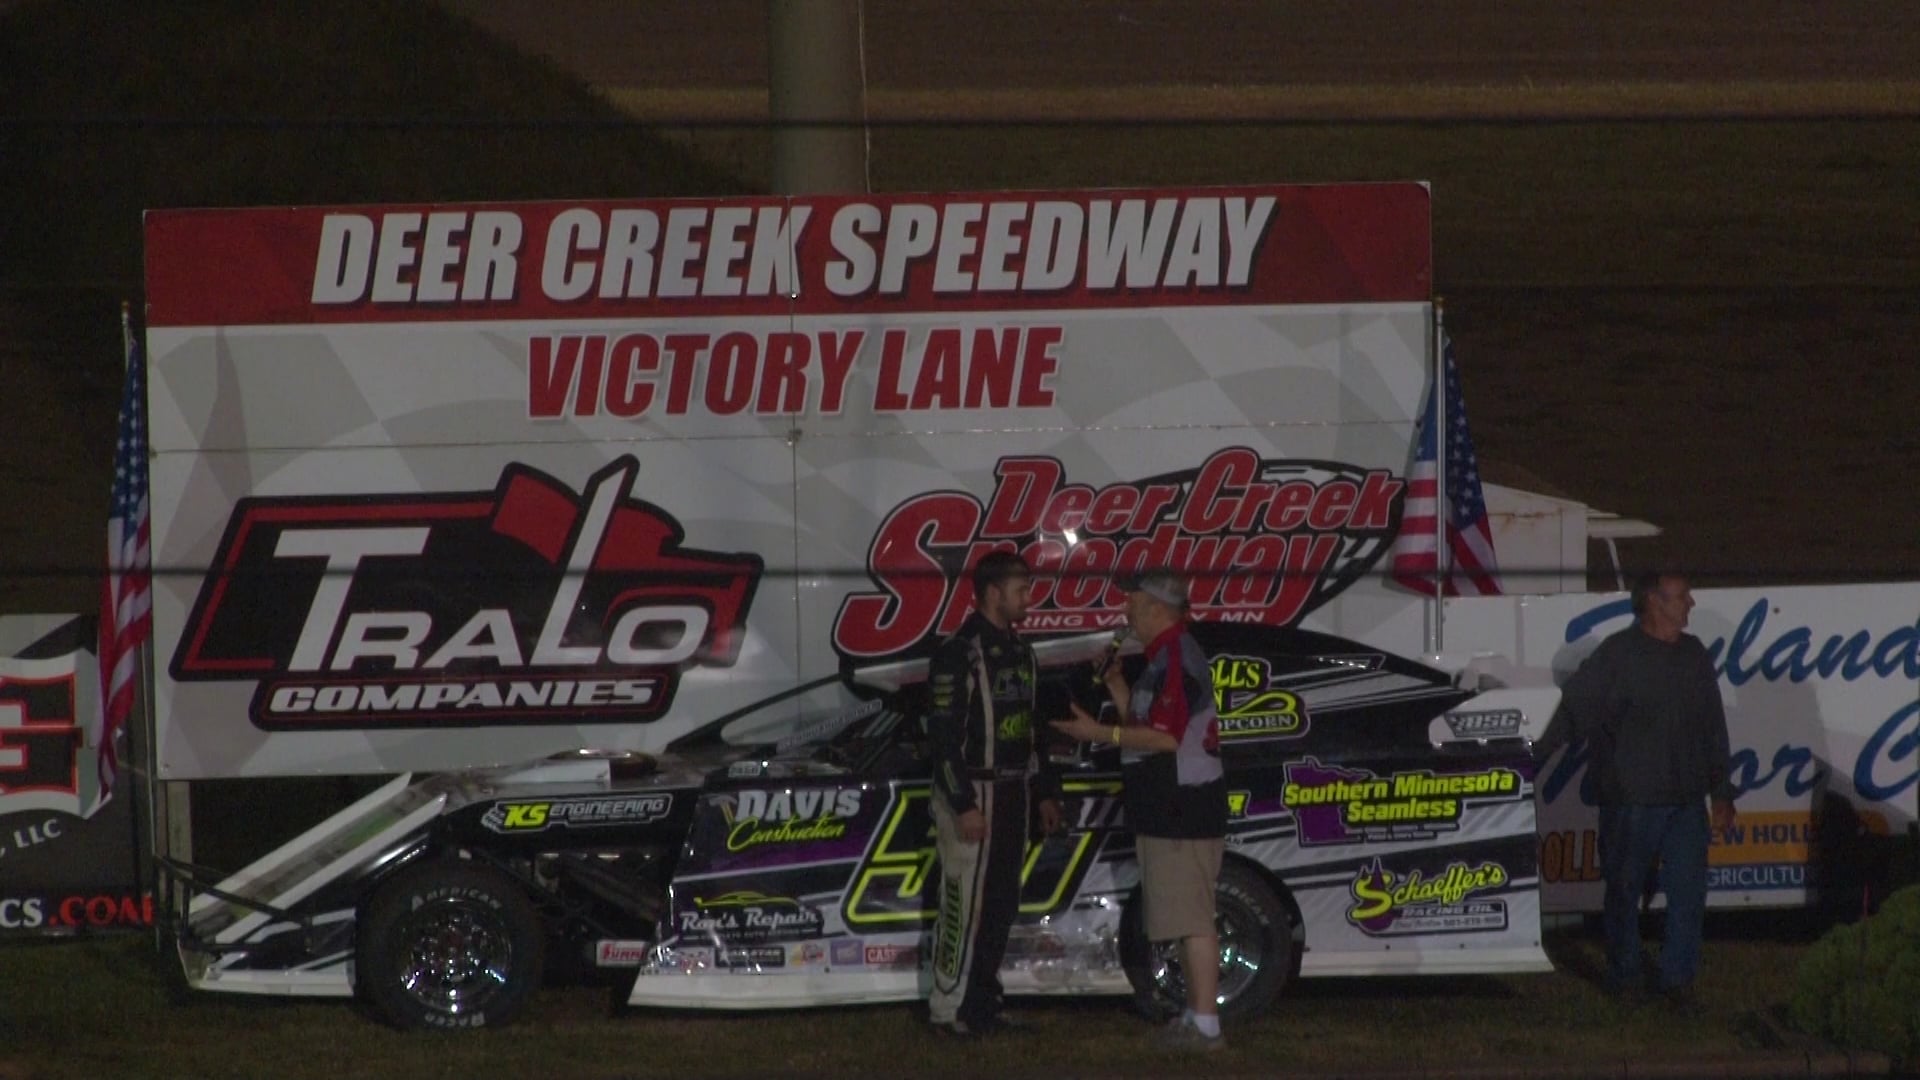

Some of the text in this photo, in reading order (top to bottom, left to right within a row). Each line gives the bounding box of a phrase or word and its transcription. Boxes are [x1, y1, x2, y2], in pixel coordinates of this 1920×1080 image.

[310, 196, 1277, 304] DEER CREEK SPEEDWAY
[528, 325, 1064, 420] VICTORY LANE
[980, 447, 1404, 538] Deer Creek
[1022, 614, 1083, 627] RING
[1220, 611, 1267, 624] MN
[1210, 658, 1261, 689] LL'S
[268, 678, 656, 713] COMPANIES
[1217, 714, 1292, 731] PCORN
[1284, 771, 1514, 806] Southern Minnesota
[503, 803, 550, 827] KS
[550, 799, 665, 816] ENGINEERING
[736, 788, 862, 822] DAVIS
[1346, 798, 1458, 824] Seamless
[13, 818, 62, 848] LLC
[727, 811, 846, 852] Construction
[1753, 824, 1811, 845] HOLL
[1542, 831, 1600, 882] OLL
[1351, 863, 1505, 919] Schaeffer's
[1706, 866, 1806, 887] GRICULTU
[744, 906, 819, 929] Repair
